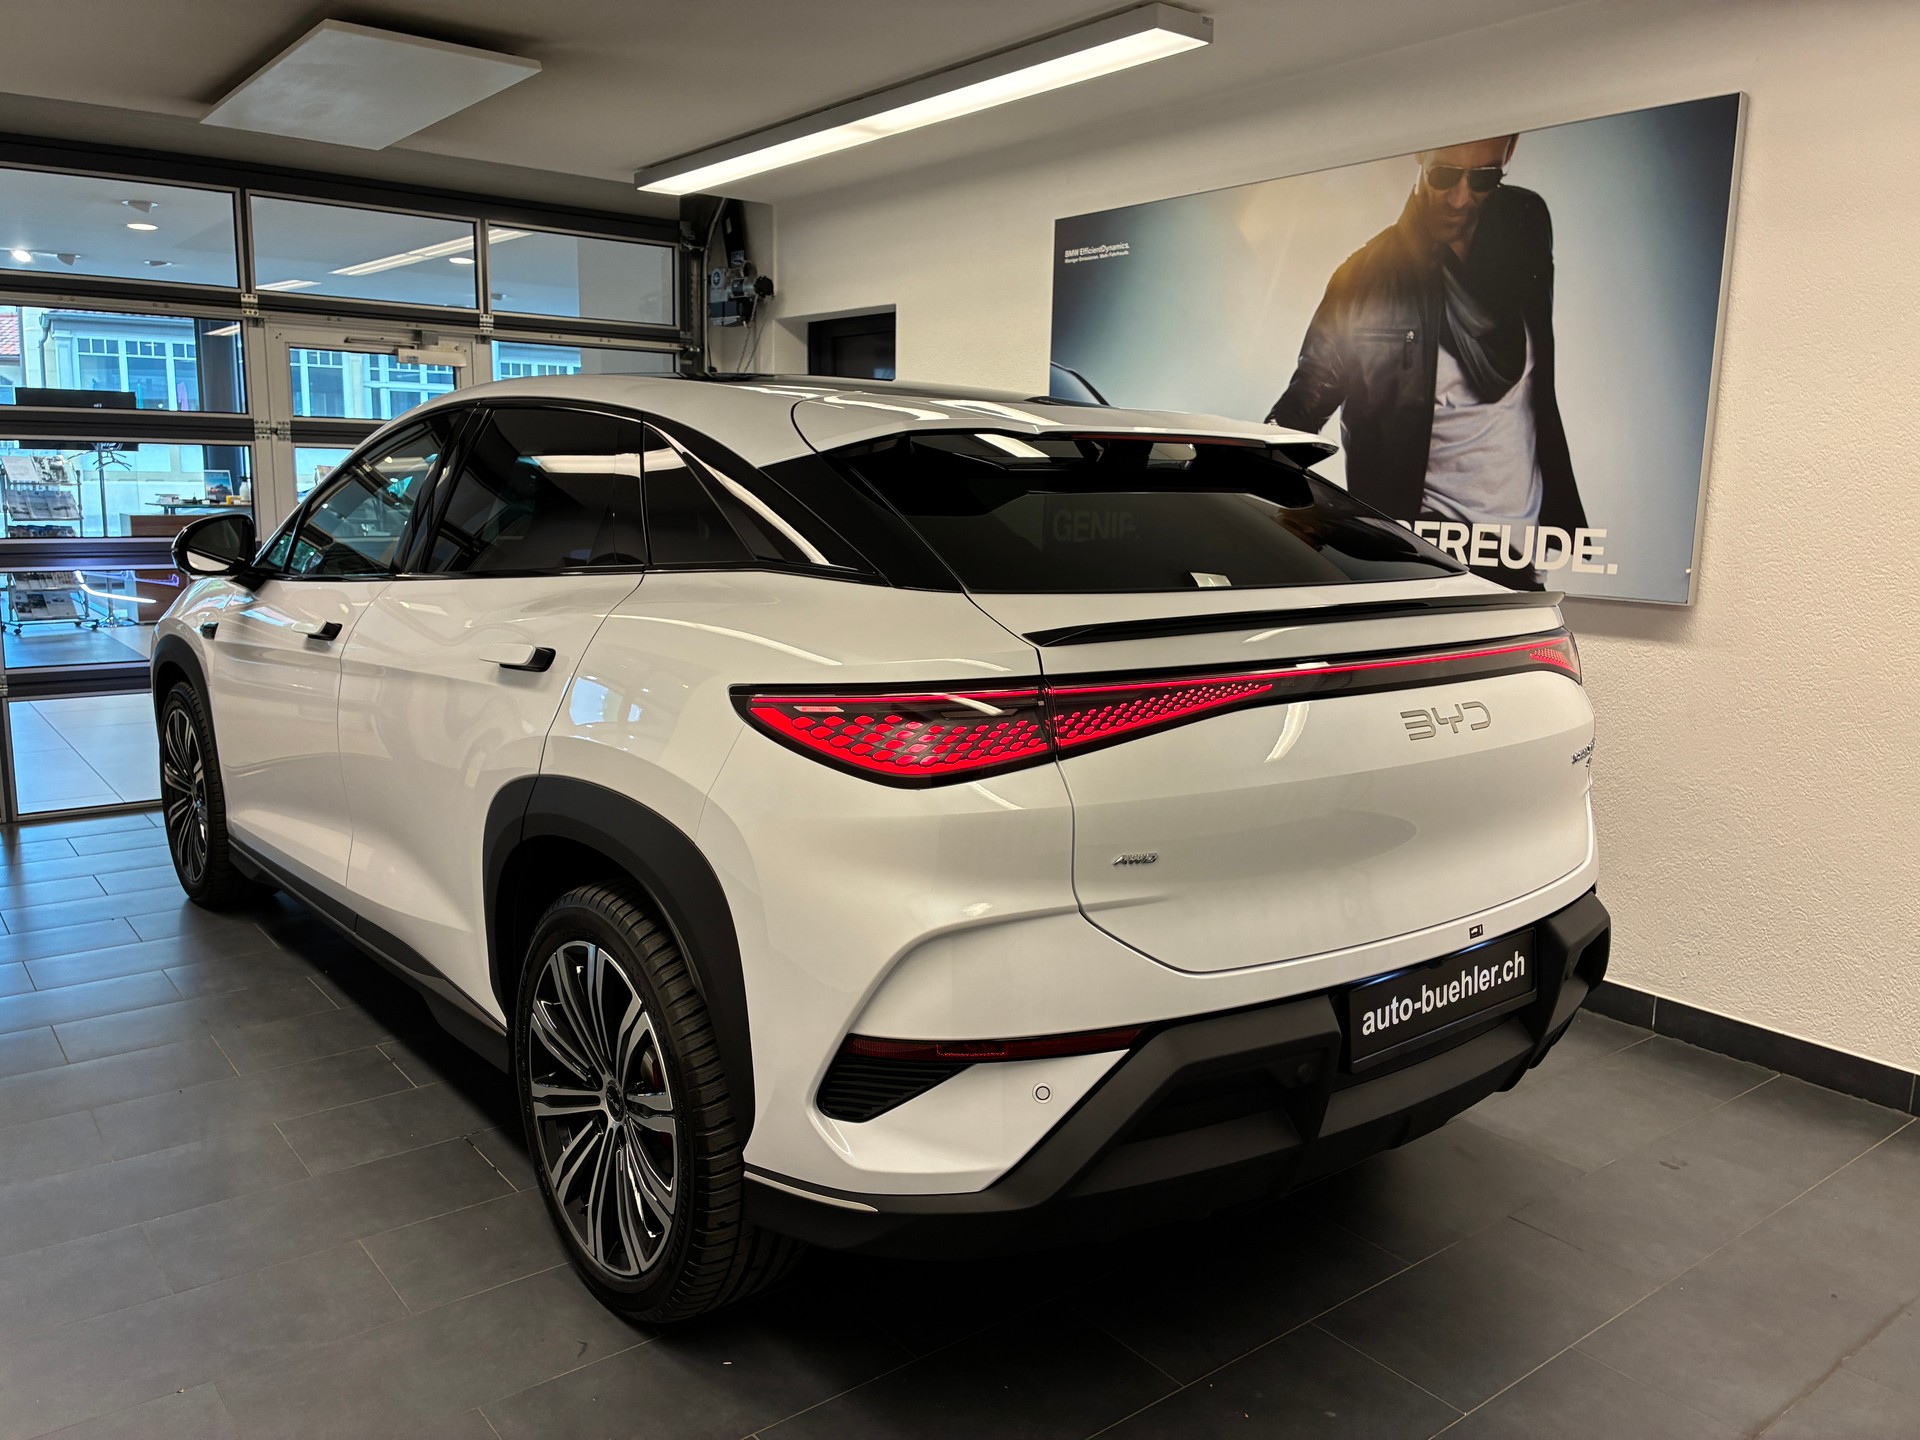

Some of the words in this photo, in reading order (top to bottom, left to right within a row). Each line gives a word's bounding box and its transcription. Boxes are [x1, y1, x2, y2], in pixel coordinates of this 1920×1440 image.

[1064, 248, 1079, 258] BMW
[1396, 519, 1618, 575] FREUDE.
[1400, 700, 1492, 741] BYD
[1362, 950, 1526, 1036] auto-buehler.ch
